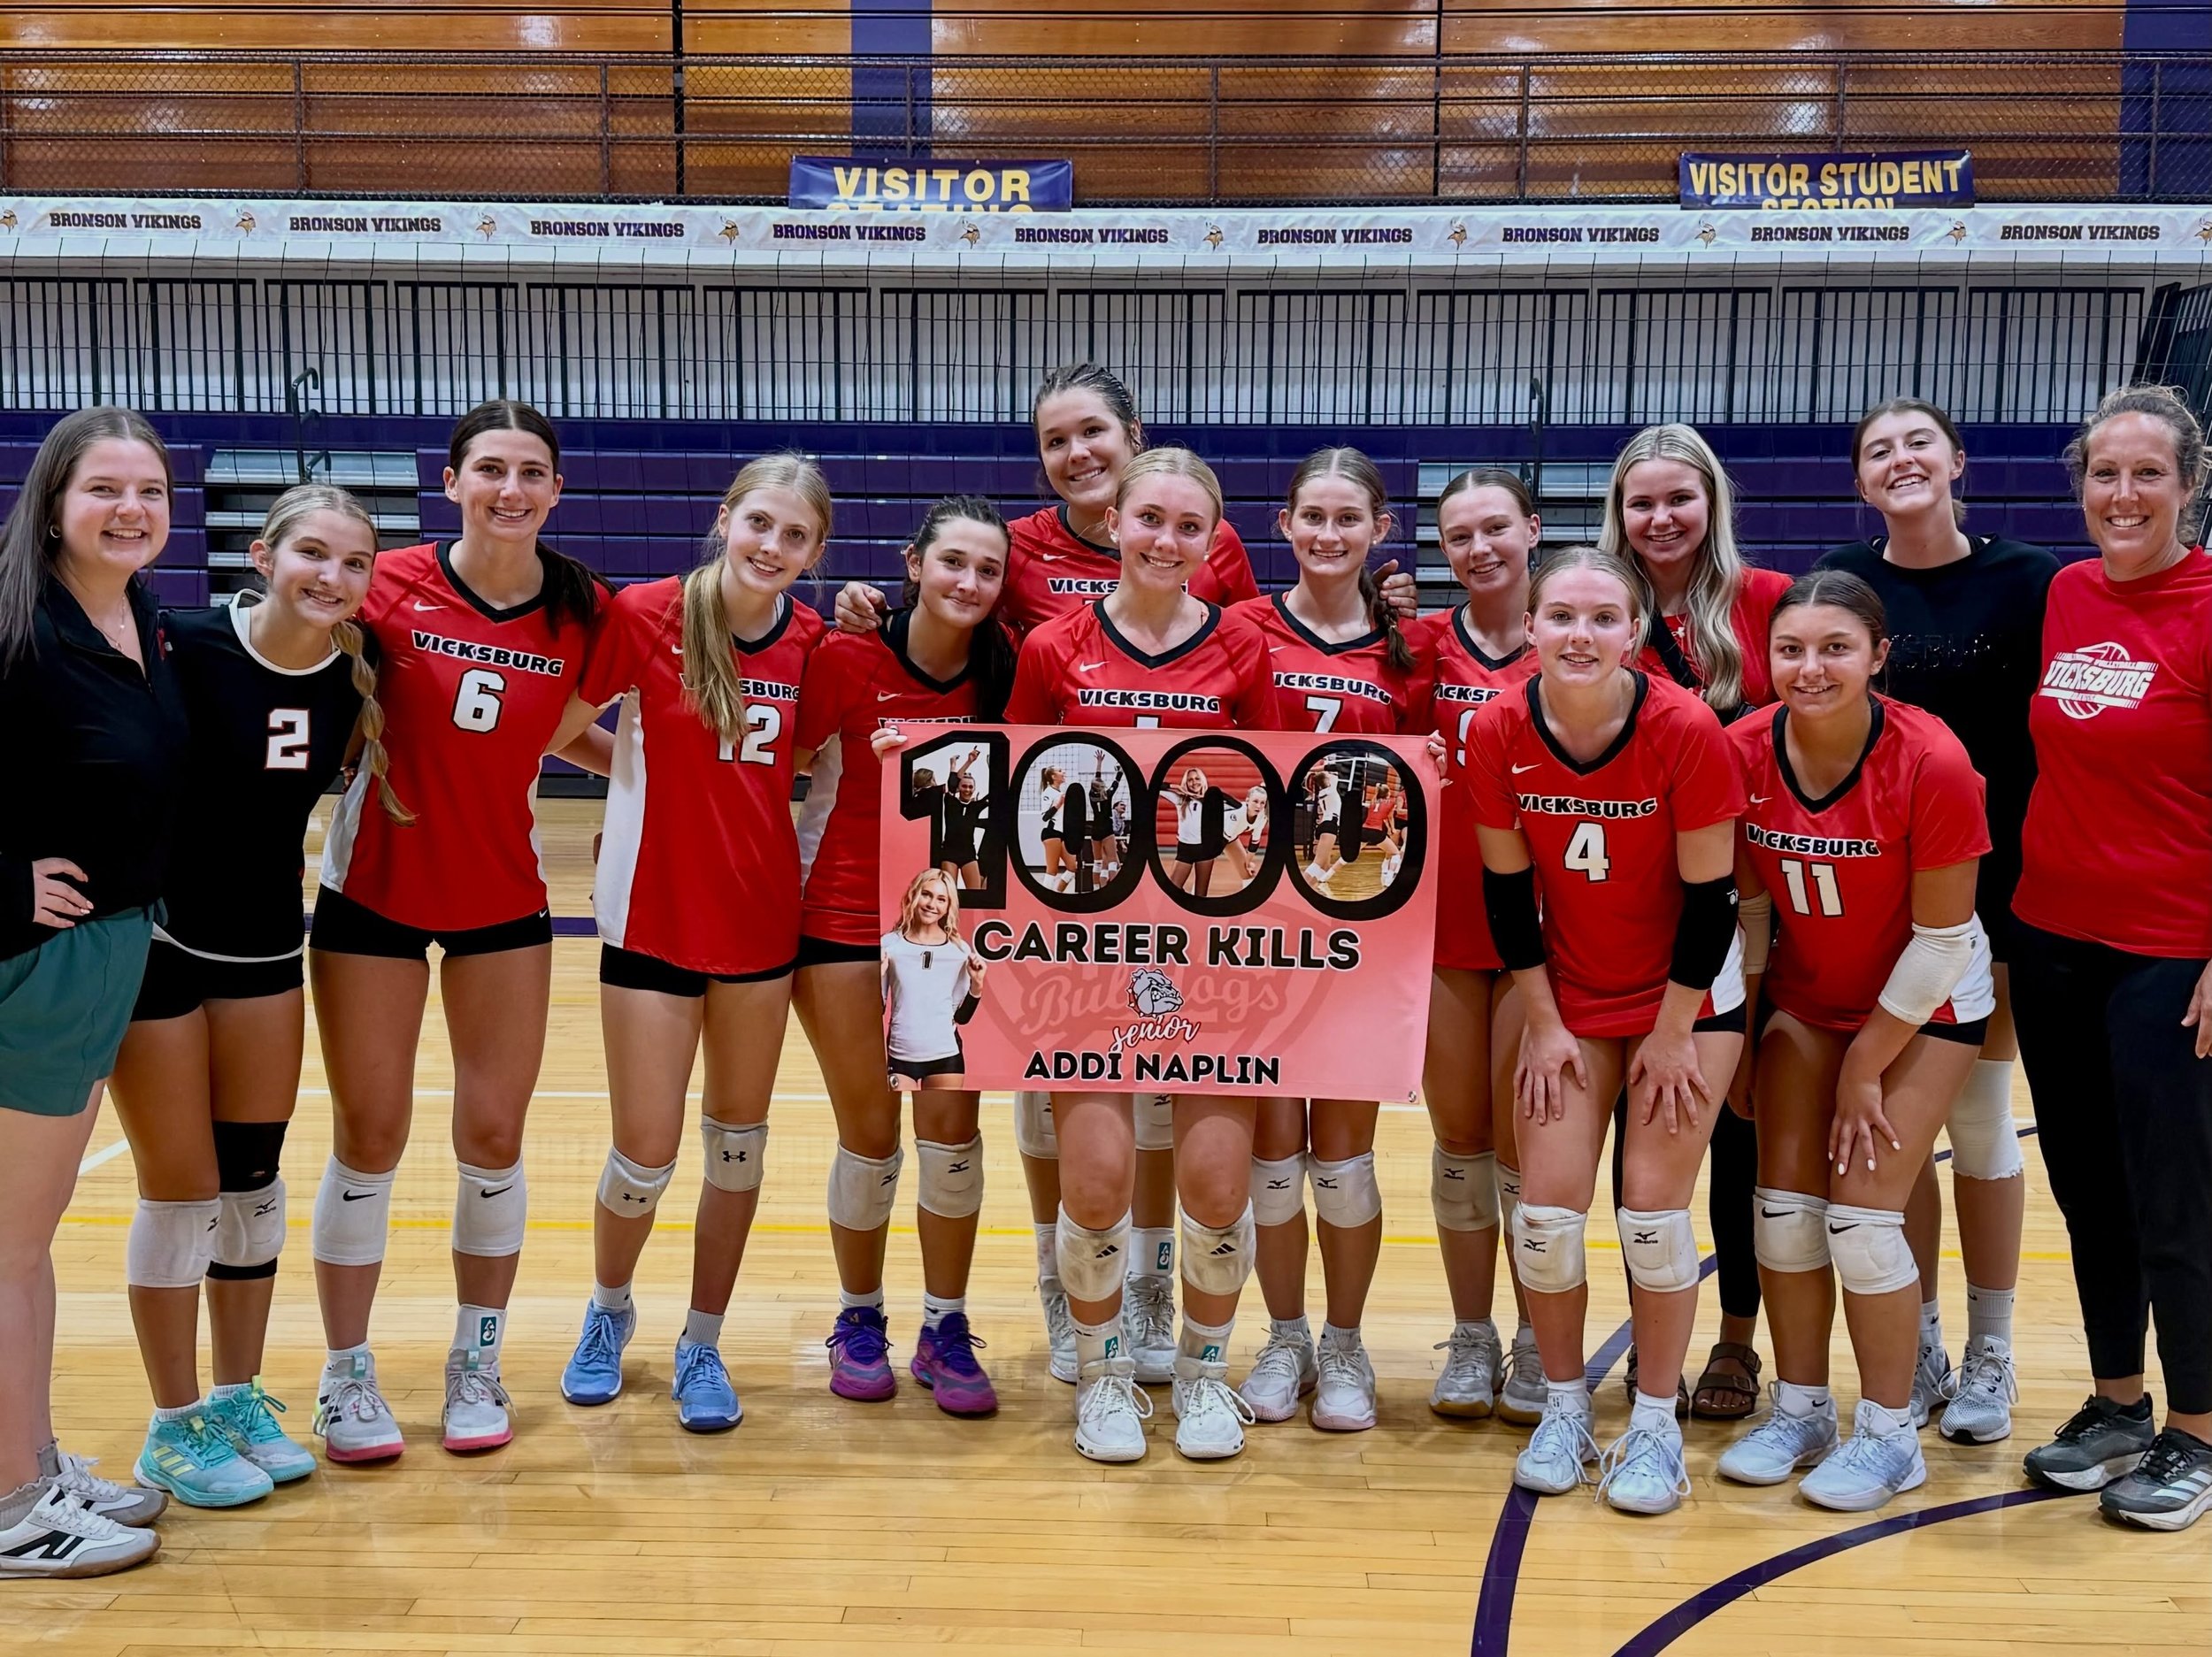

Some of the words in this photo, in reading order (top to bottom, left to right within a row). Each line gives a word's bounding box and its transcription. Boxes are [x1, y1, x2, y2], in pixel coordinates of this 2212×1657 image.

[833, 166, 1032, 203] VISITOR
[1688, 163, 1810, 197] VISITOR
[1818, 159, 1962, 196] STUDENT
[49, 212, 127, 228] BRONSON
[130, 214, 202, 229] VIKINGS
[289, 217, 368, 233] BRONSON
[371, 217, 442, 234] VIKINGS
[530, 219, 610, 237] BRONSON
[612, 221, 685, 239] VIKINGS
[772, 223, 851, 241] BRONSON
[855, 224, 926, 242] VIKINGS
[1014, 226, 1094, 244] BRONSON
[1097, 226, 1169, 245] VIKINGS
[1257, 227, 1337, 245] BRONSON
[1340, 226, 1413, 245] VIKINGS
[1502, 226, 1583, 244] BRONSON
[1586, 226, 1660, 243] VIKINGS
[1750, 226, 1833, 242] BRONSON
[1837, 225, 1910, 242] VIKINGS
[2000, 224, 2084, 242] BRONSON
[2087, 224, 2161, 242] VIKINGS
[1047, 577, 1122, 595] VICKS
[411, 629, 565, 677] VICKSBURG
[1272, 671, 1393, 706] ICKSBURG
[2042, 660, 2155, 700] VICKSBURG
[450, 667, 508, 734] 6
[1077, 688, 1222, 714] VICKSBURG
[1304, 694, 1345, 733] 7
[265, 708, 310, 770] 2
[1516, 792, 1658, 819] VICKSBURG
[900, 730, 1428, 922] 1000
[1746, 822, 1882, 858] VICKSBURG
[1563, 819, 1612, 884] 4
[1779, 856, 1846, 917] 11
[974, 920, 1191, 970] CAREER
[1208, 924, 1362, 972] KILLS
[1019, 961, 1279, 1035] Bulogs
[1109, 1014, 1202, 1054] senior
[1023, 1049, 1124, 1082] ADDI
[1133, 1053, 1281, 1086] NAPLIN
